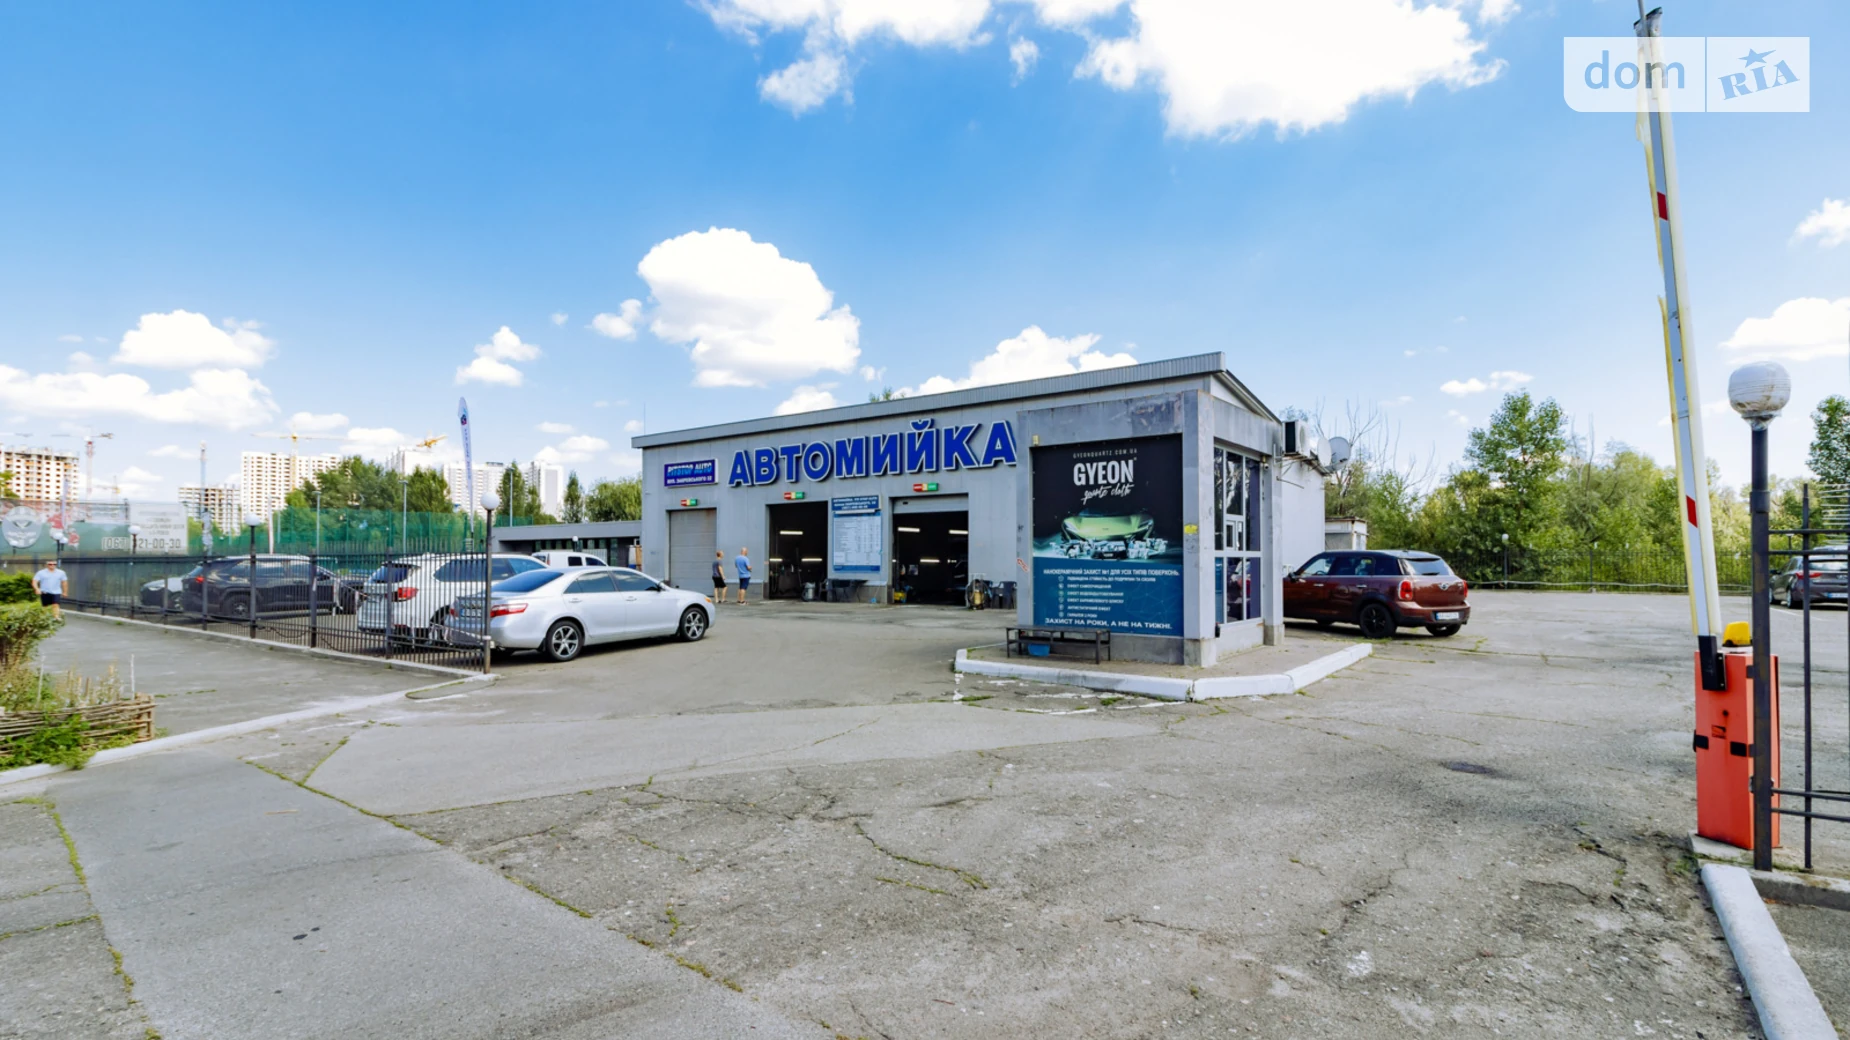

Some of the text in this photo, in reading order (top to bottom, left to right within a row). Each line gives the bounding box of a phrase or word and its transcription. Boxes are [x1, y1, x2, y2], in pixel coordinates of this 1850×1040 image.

[728, 418, 1017, 487] АВТОМИЙКА
[667, 462, 712, 477] PITSTOP AUTO
[1073, 459, 1134, 486] GYEON
[131, 538, 181, 549] 21-00-30
